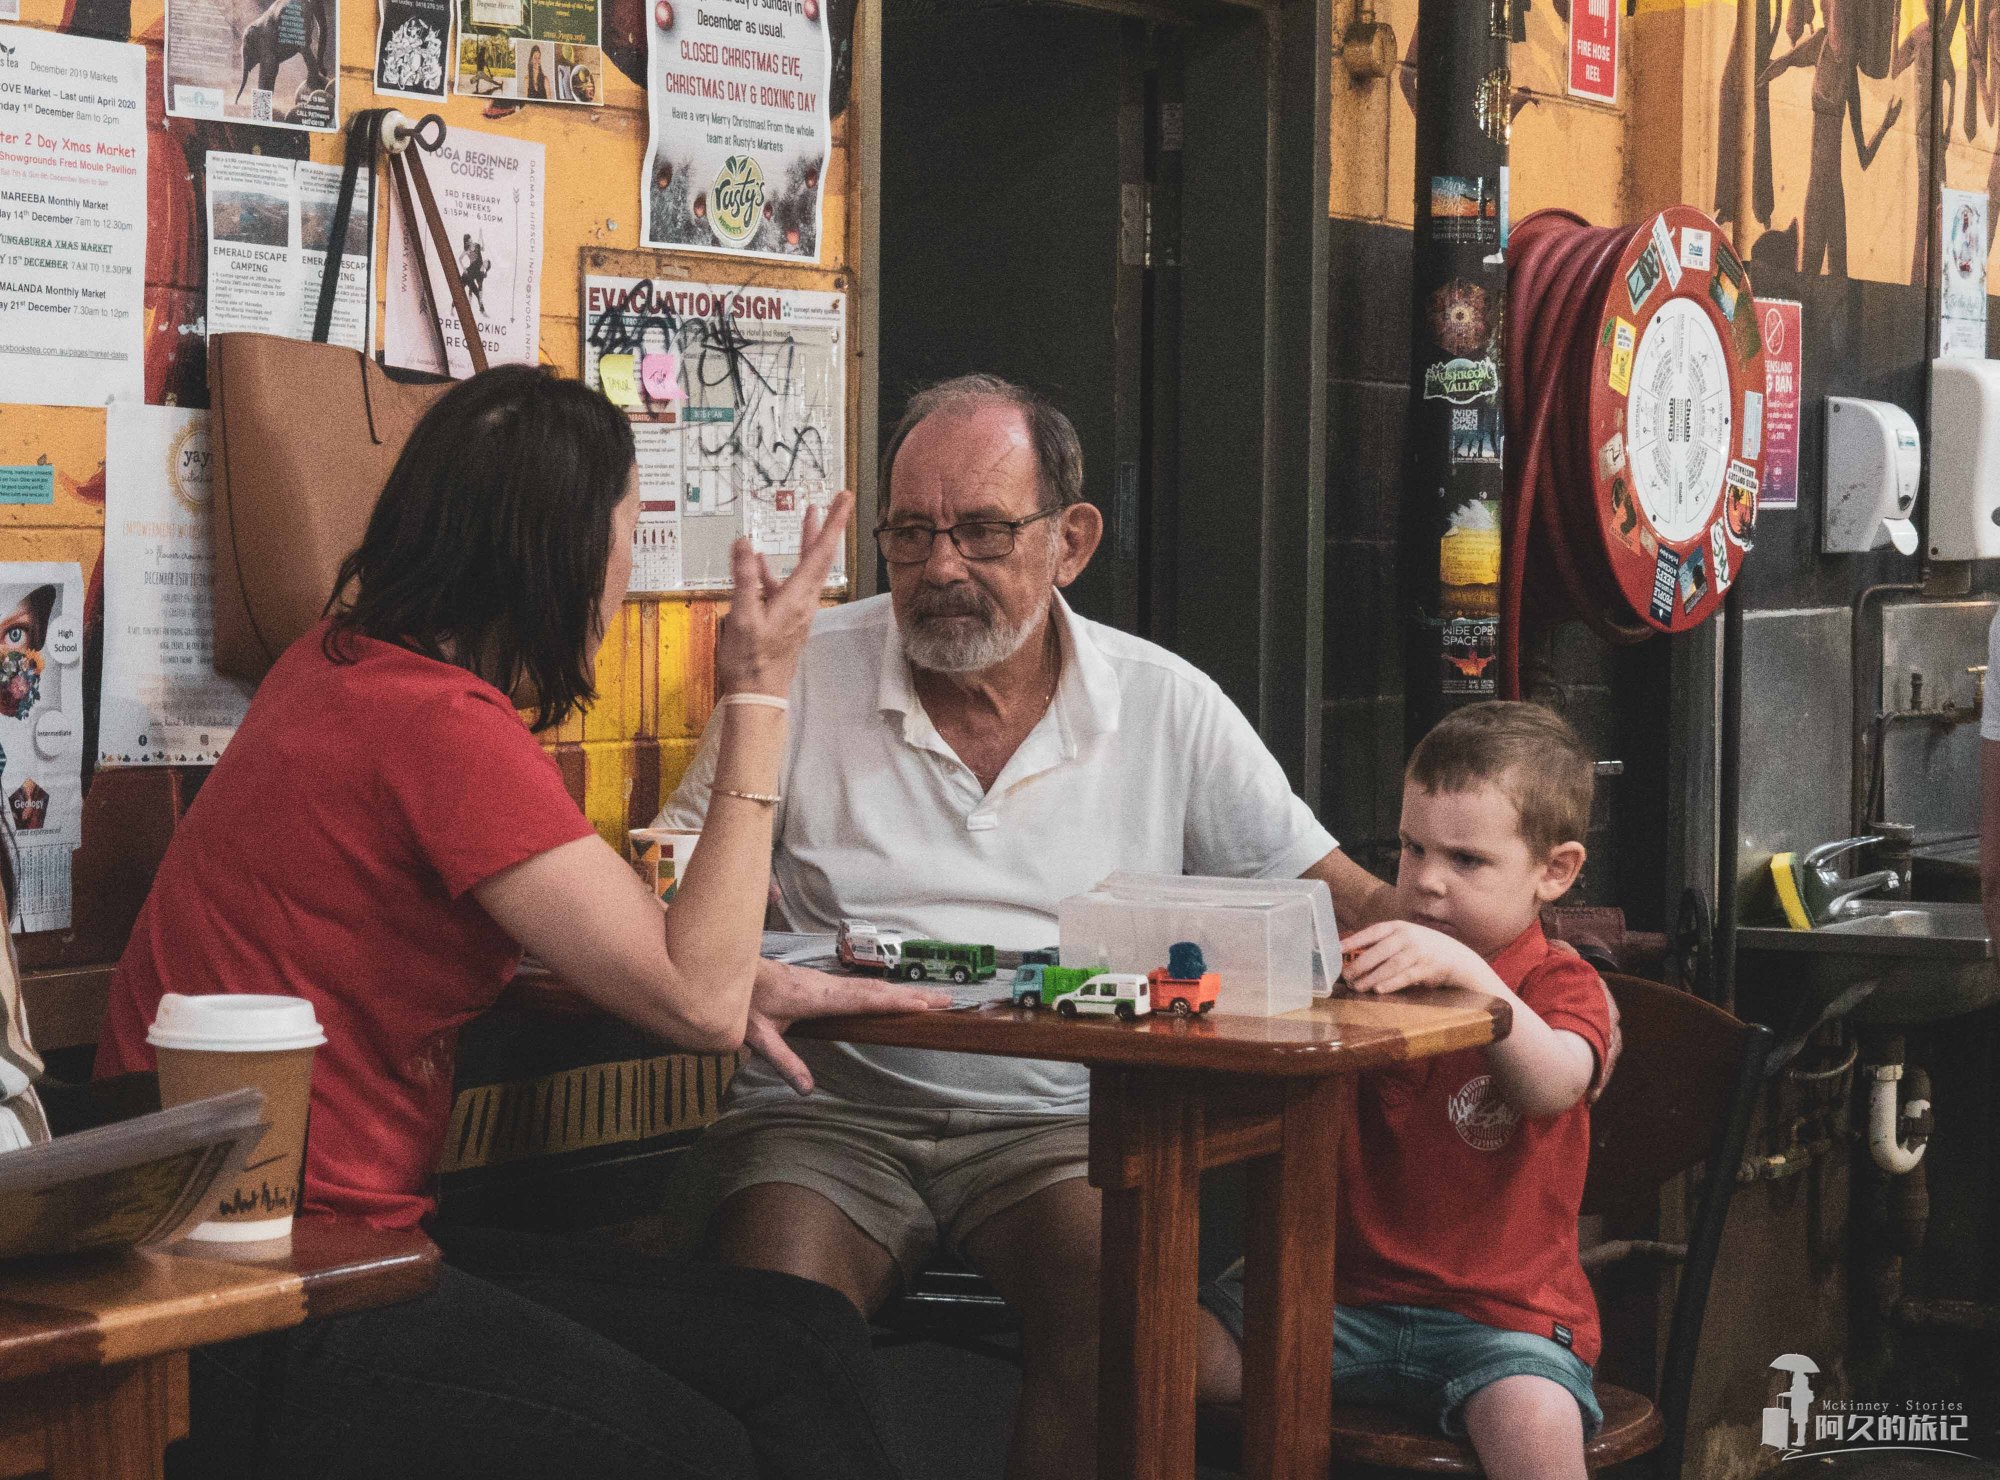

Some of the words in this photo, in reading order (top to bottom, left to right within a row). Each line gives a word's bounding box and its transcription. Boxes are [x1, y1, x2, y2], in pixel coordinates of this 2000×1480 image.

[697, 9, 743, 32] December
[745, 22, 756, 34] as
[758, 23, 786, 39] usual.
[1577, 39, 1591, 57] FIRE
[1593, 43, 1610, 62] HOSE
[6, 56, 19, 68] tea
[680, 40, 718, 65] CLOSED
[721, 46, 779, 73] CHRISTMAS
[781, 55, 804, 82] EVE,
[30, 61, 68, 76] December
[69, 67, 88, 79] 2019
[89, 71, 119, 84] Markets
[1585, 63, 1600, 82] REEL
[0, 82, 22, 94] OVE
[24, 84, 51, 98] Market
[60, 90, 77, 102] Last
[79, 95, 95, 105] until
[97, 97, 116, 111] April
[118, 99, 136, 110] 2020
[665, 72, 725, 99] CHRISTMAS
[728, 81, 747, 103] DAY
[750, 85, 758, 104] &
[760, 87, 795, 110] BOXING
[797, 91, 816, 113] DAY
[23, 103, 33, 112] 1st
[35, 104, 74, 118] December
[76, 110, 92, 121] 8am
[94, 113, 101, 122] to
[103, 114, 119, 125] 2pm
[672, 107, 688, 120] Have
[690, 111, 694, 121] a
[695, 113, 709, 125] very
[711, 112, 731, 130] Merry
[732, 115, 766, 131] Christmas!
[767, 119, 783, 133] From
[785, 123, 796, 135] the
[797, 124, 815, 137] whole
[25, 133, 32, 146] 2
[37, 134, 57, 152] Day
[62, 137, 91, 153] Xmas
[97, 142, 136, 158] Market
[706, 134, 723, 146] team
[725, 135, 732, 146] at
[733, 136, 756, 152] Rusty's
[757, 140, 784, 153] Markets
[0, 152, 57, 166] Showgrounds
[59, 157, 77, 168] Fred
[79, 160, 104, 172] Moule
[106, 163, 137, 176] Pavilion
[429, 147, 460, 161] OGA
[465, 150, 519, 171] BEGINNER
[451, 162, 495, 180] COURSE
[1, 190, 46, 204] MAREEBA
[48, 195, 80, 209] Monthly
[83, 199, 108, 210] Market
[445, 189, 459, 199] 3RD
[461, 192, 501, 205] FEBRUARY
[714, 166, 766, 228] rusty's
[455, 200, 463, 208] 10
[466, 201, 491, 213] WEEKS
[14, 209, 29, 220] 14th
[32, 212, 73, 225] December
[75, 216, 91, 227] 7am
[93, 218, 101, 228] to
[103, 219, 133, 231] 12.30pm
[718, 215, 742, 235] MARKETS
[55, 237, 79, 250] XMAS
[81, 241, 113, 254] MARKET
[213, 246, 252, 259] EMERALD
[254, 249, 287, 262] ESCAPE
[24, 257, 68, 270] DECEMBER
[72, 261, 88, 271] 7AM
[90, 263, 99, 272] TO
[102, 264, 132, 275] 12.30PM
[231, 261, 268, 273] CAMPING
[341, 260, 366, 270] ESCAP
[318, 270, 355, 282] CING
[0, 281, 43, 293] MALANDA
[45, 283, 79, 298] Monthly
[81, 288, 106, 299] Market
[10, 300, 26, 310] 21st
[28, 301, 71, 314] December
[73, 305, 99, 316] 7.30am
[101, 307, 108, 317] to
[110, 308, 129, 319] 12pm
[588, 287, 726, 318] EVACUATION
[732, 295, 782, 320] SIGN
[478, 322, 507, 336] OKING
[446, 336, 500, 352] REQRED
[1432, 368, 1491, 383] MUSHROOM
[1775, 375, 1792, 393] BAN
[1443, 378, 1483, 394] VALLEY
[1452, 409, 1478, 417] WIDE
[1452, 416, 1478, 424] OPEN
[1667, 398, 1675, 442] Chubb
[1684, 398, 1692, 442] Chubb
[1452, 423, 1478, 431] SPACE
[1728, 471, 1746, 486] ODYSSEY
[1733, 463, 1754, 478] AUSTRALIA
[1655, 568, 1675, 587] REEFS
[1653, 587, 1673, 605] PEOPLE
[58, 629, 73, 642] High
[1442, 625, 1471, 635] WIDE
[1473, 625, 1496, 636] OPEN
[54, 643, 78, 653] School
[1442, 635, 1478, 646] SPACE
[14, 799, 44, 809] Geology
